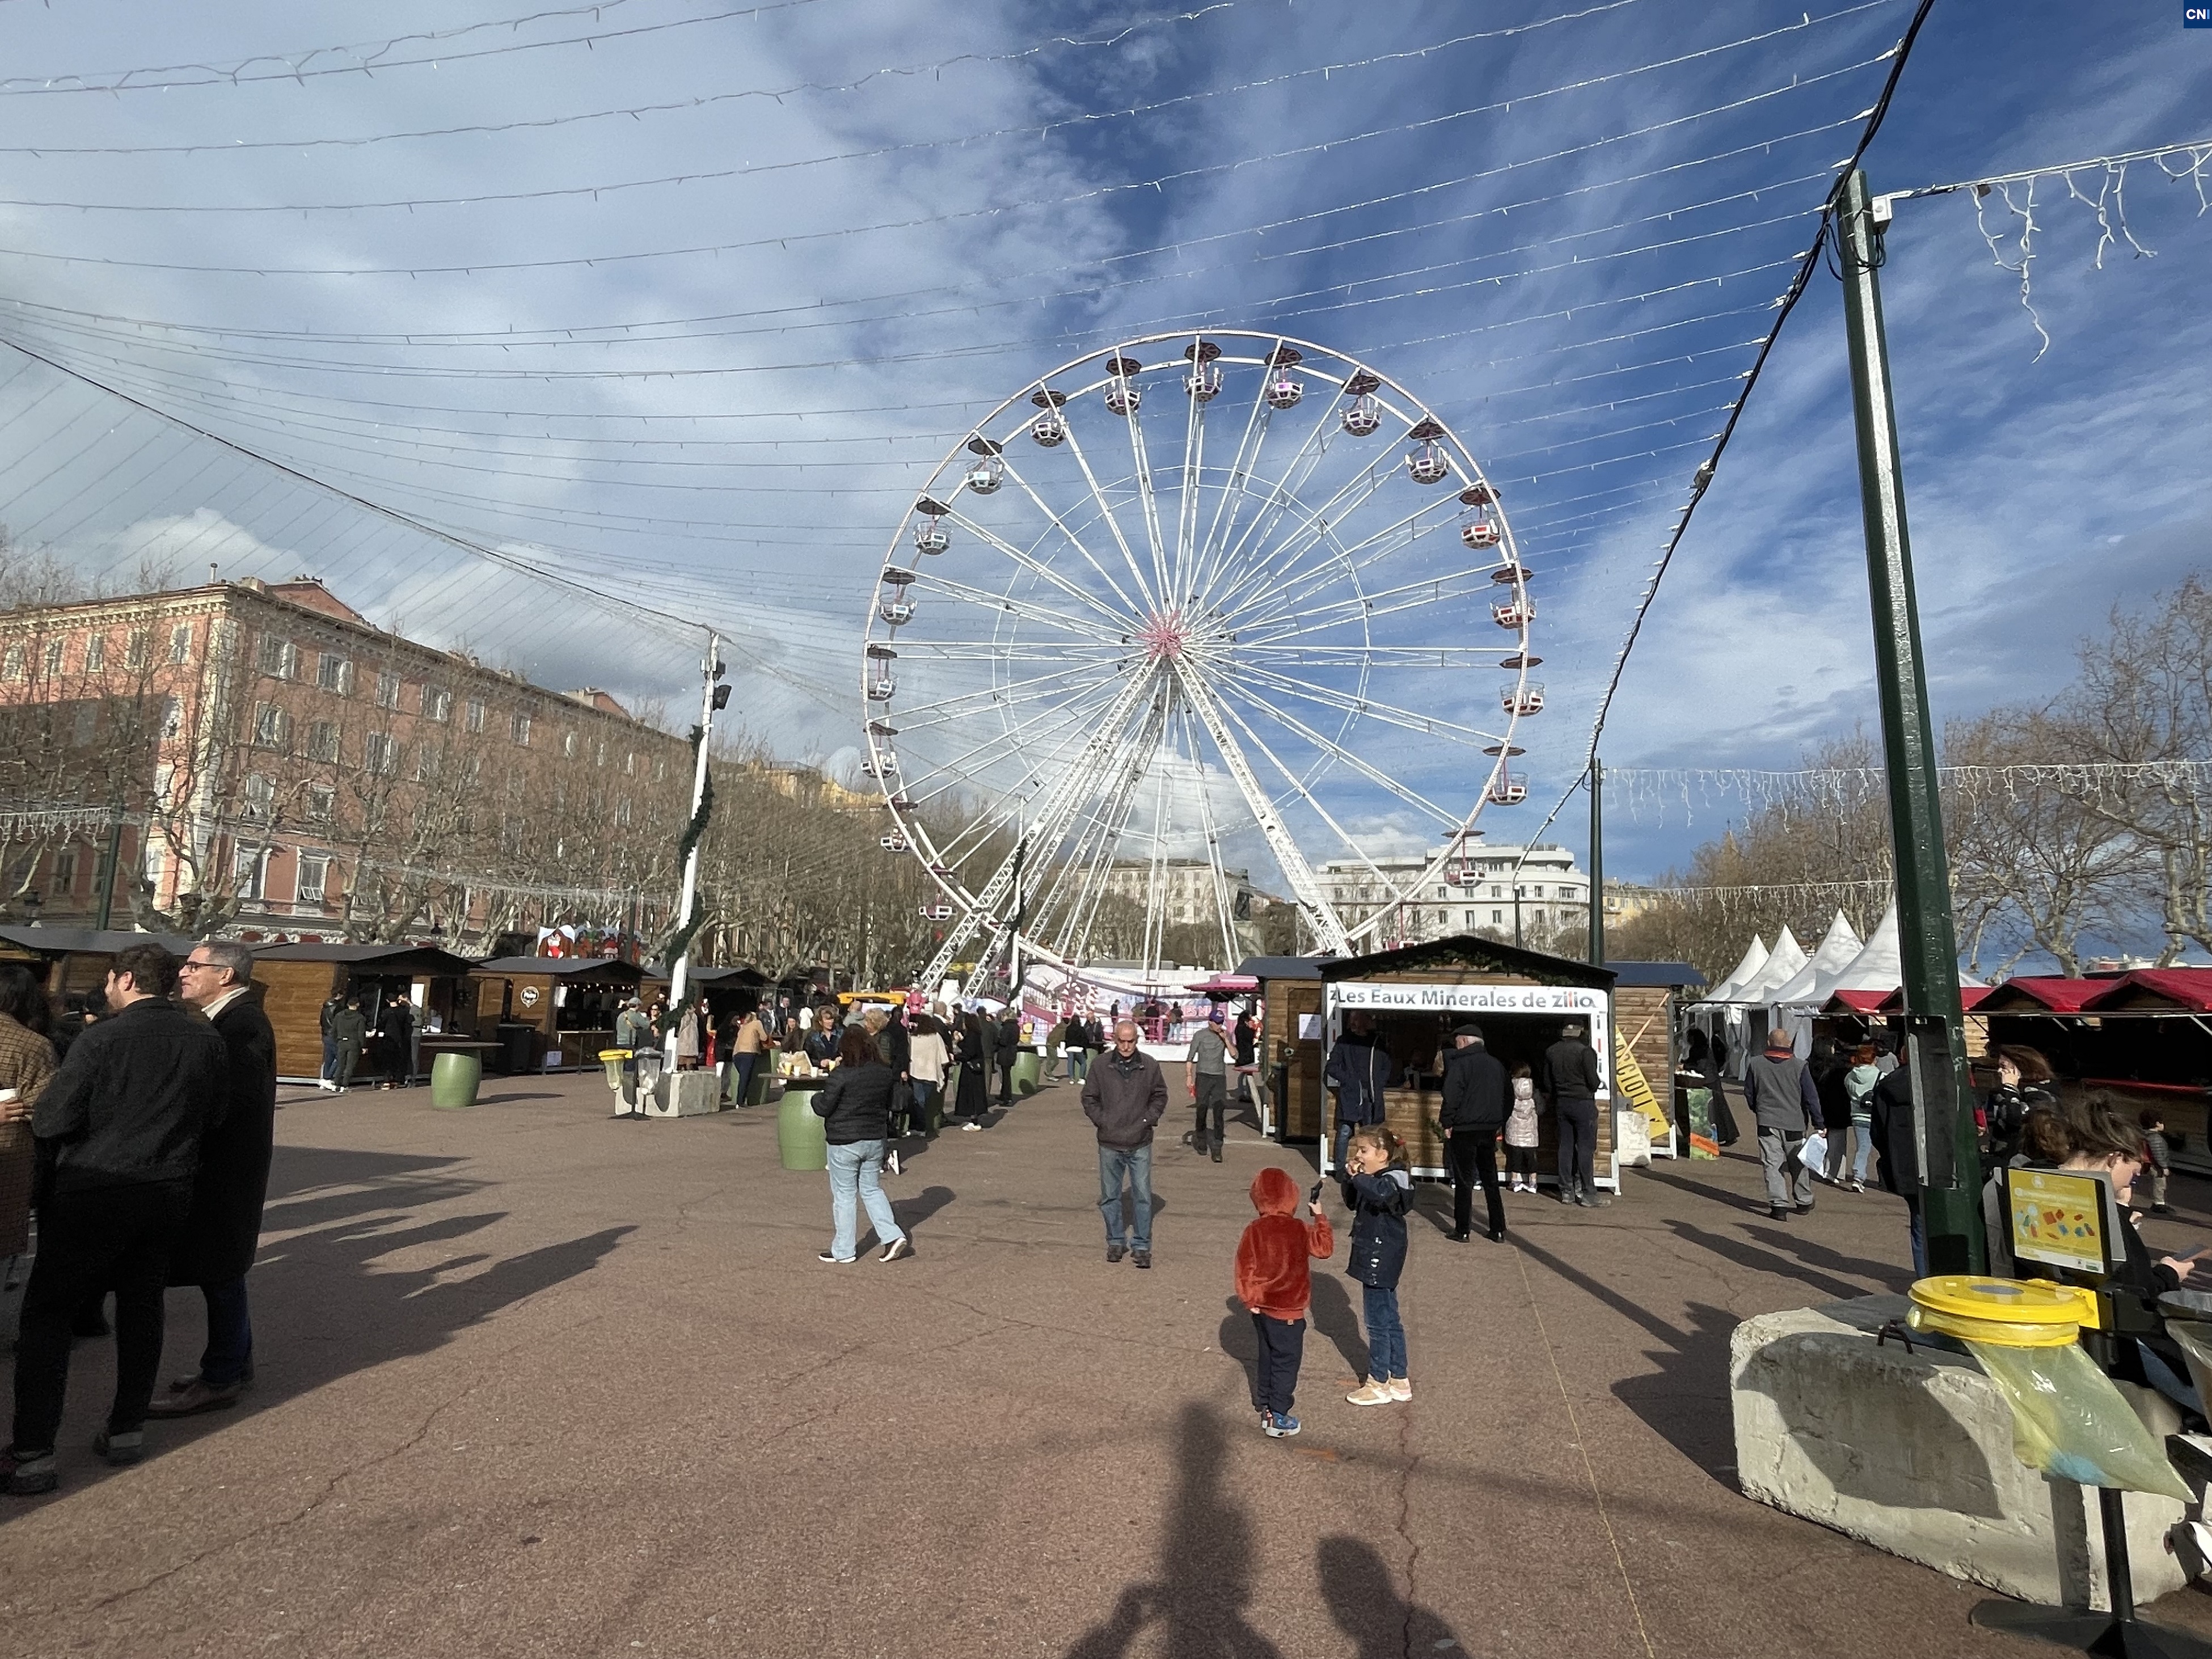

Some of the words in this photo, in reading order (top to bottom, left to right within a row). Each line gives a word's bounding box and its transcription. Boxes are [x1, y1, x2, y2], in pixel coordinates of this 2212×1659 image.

[1337, 989, 1365, 1003] Les
[1371, 989, 1417, 1004] Eaux
[1422, 990, 1517, 1007] Minerales
[1522, 992, 1547, 1008] de
